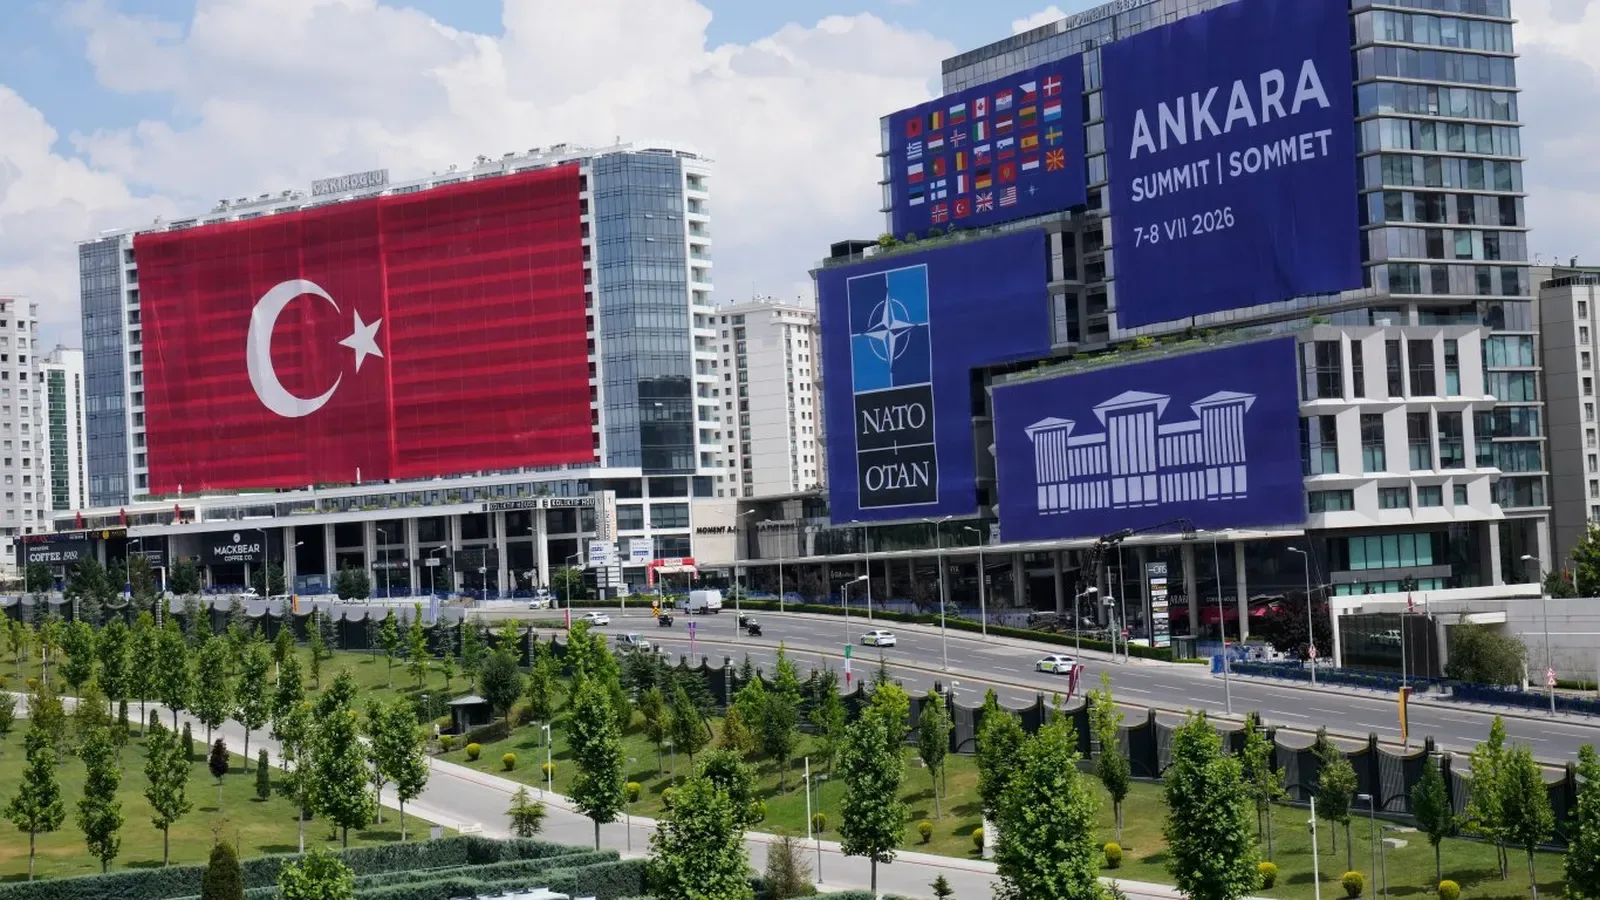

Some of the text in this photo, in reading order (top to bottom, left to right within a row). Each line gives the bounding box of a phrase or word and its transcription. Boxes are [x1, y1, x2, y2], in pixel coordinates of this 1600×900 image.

[1129, 59, 1331, 160] ANKARA
[1131, 128, 1333, 202] SUMMIT SOMMET
[1133, 206, 1236, 248] 7-8 VII 2026
[861, 402, 926, 435] NATO
[865, 461, 929, 491] OTAN
[29, 551, 61, 563] COFFEE
[214, 543, 260, 556] MACKBEAR
